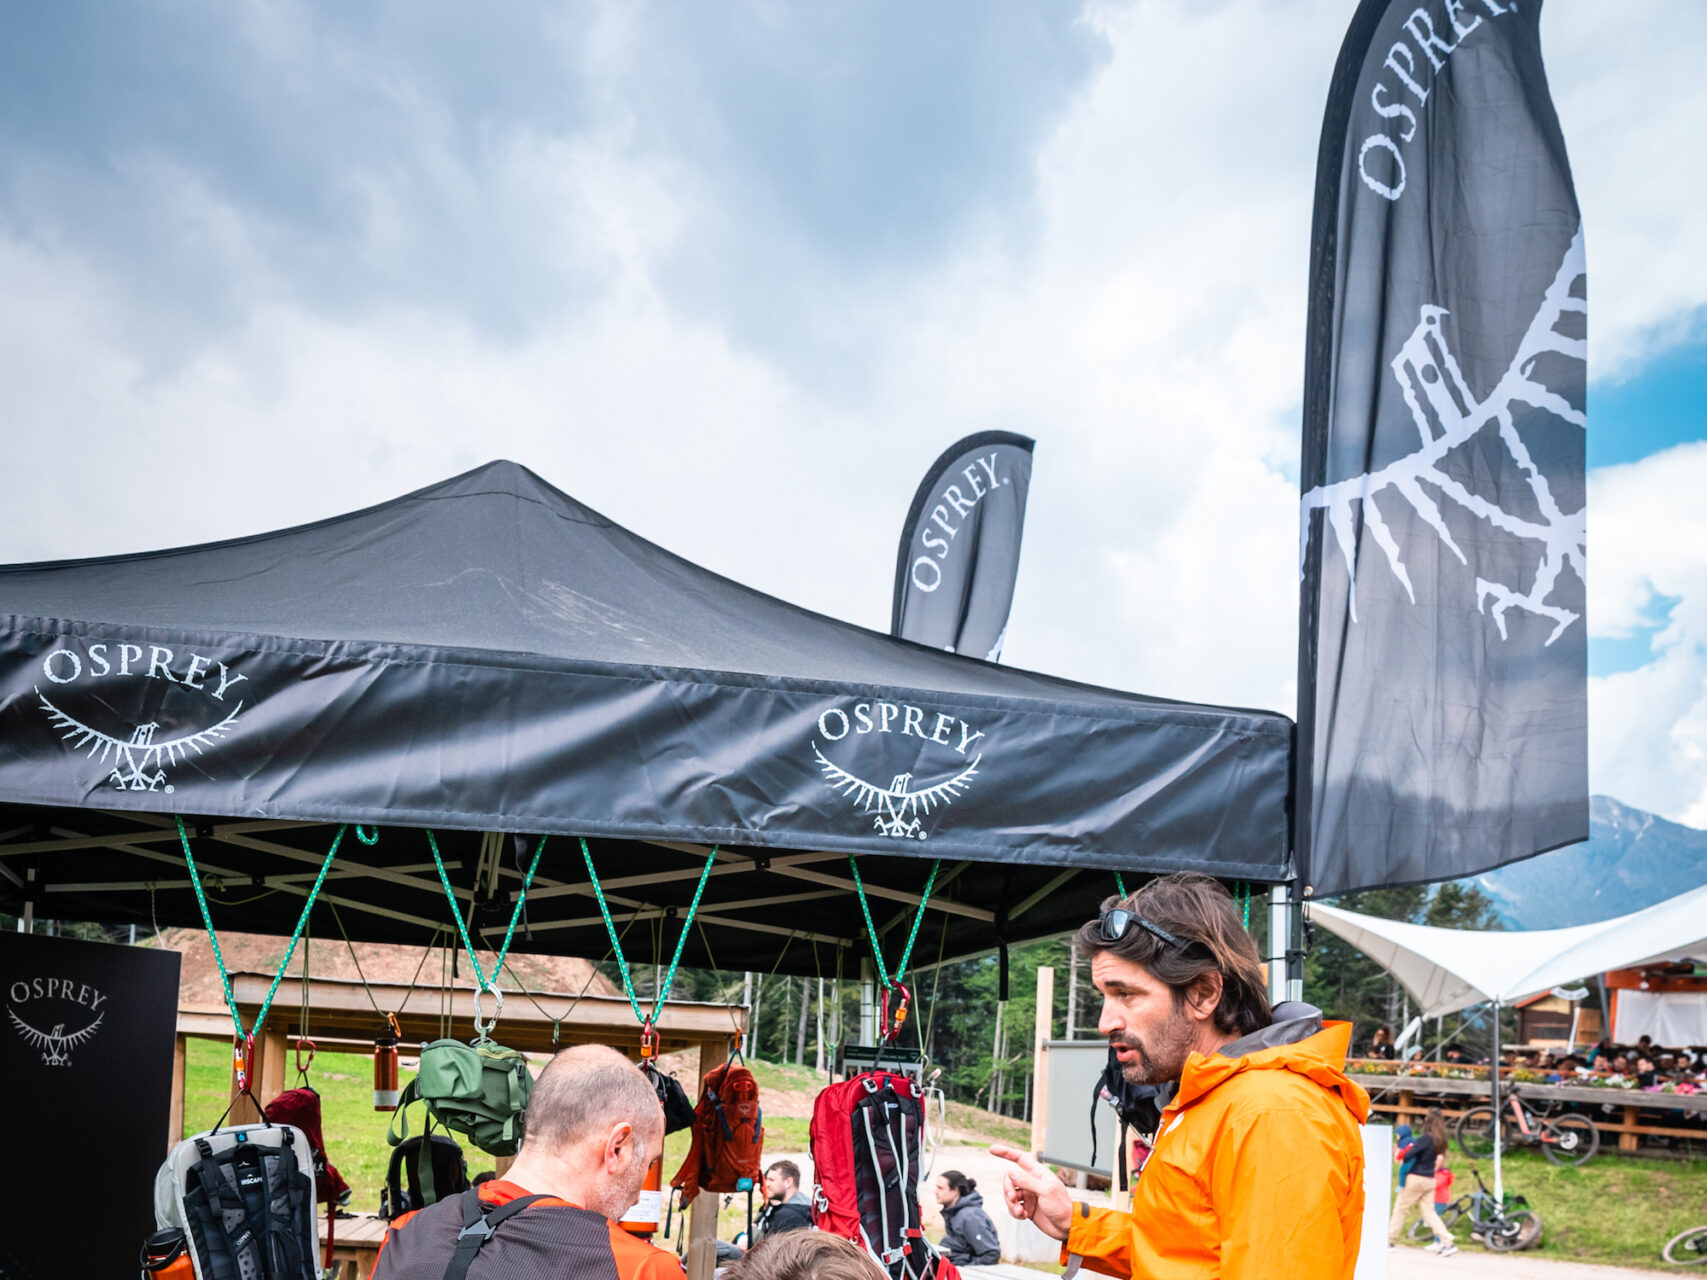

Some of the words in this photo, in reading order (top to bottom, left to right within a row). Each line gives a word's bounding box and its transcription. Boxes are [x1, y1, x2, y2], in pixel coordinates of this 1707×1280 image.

[912, 452, 1000, 592] OSPREY
[43, 644, 248, 701] OSPREY
[818, 702, 985, 755] OSPREY
[10, 977, 108, 1012] OSPREY
